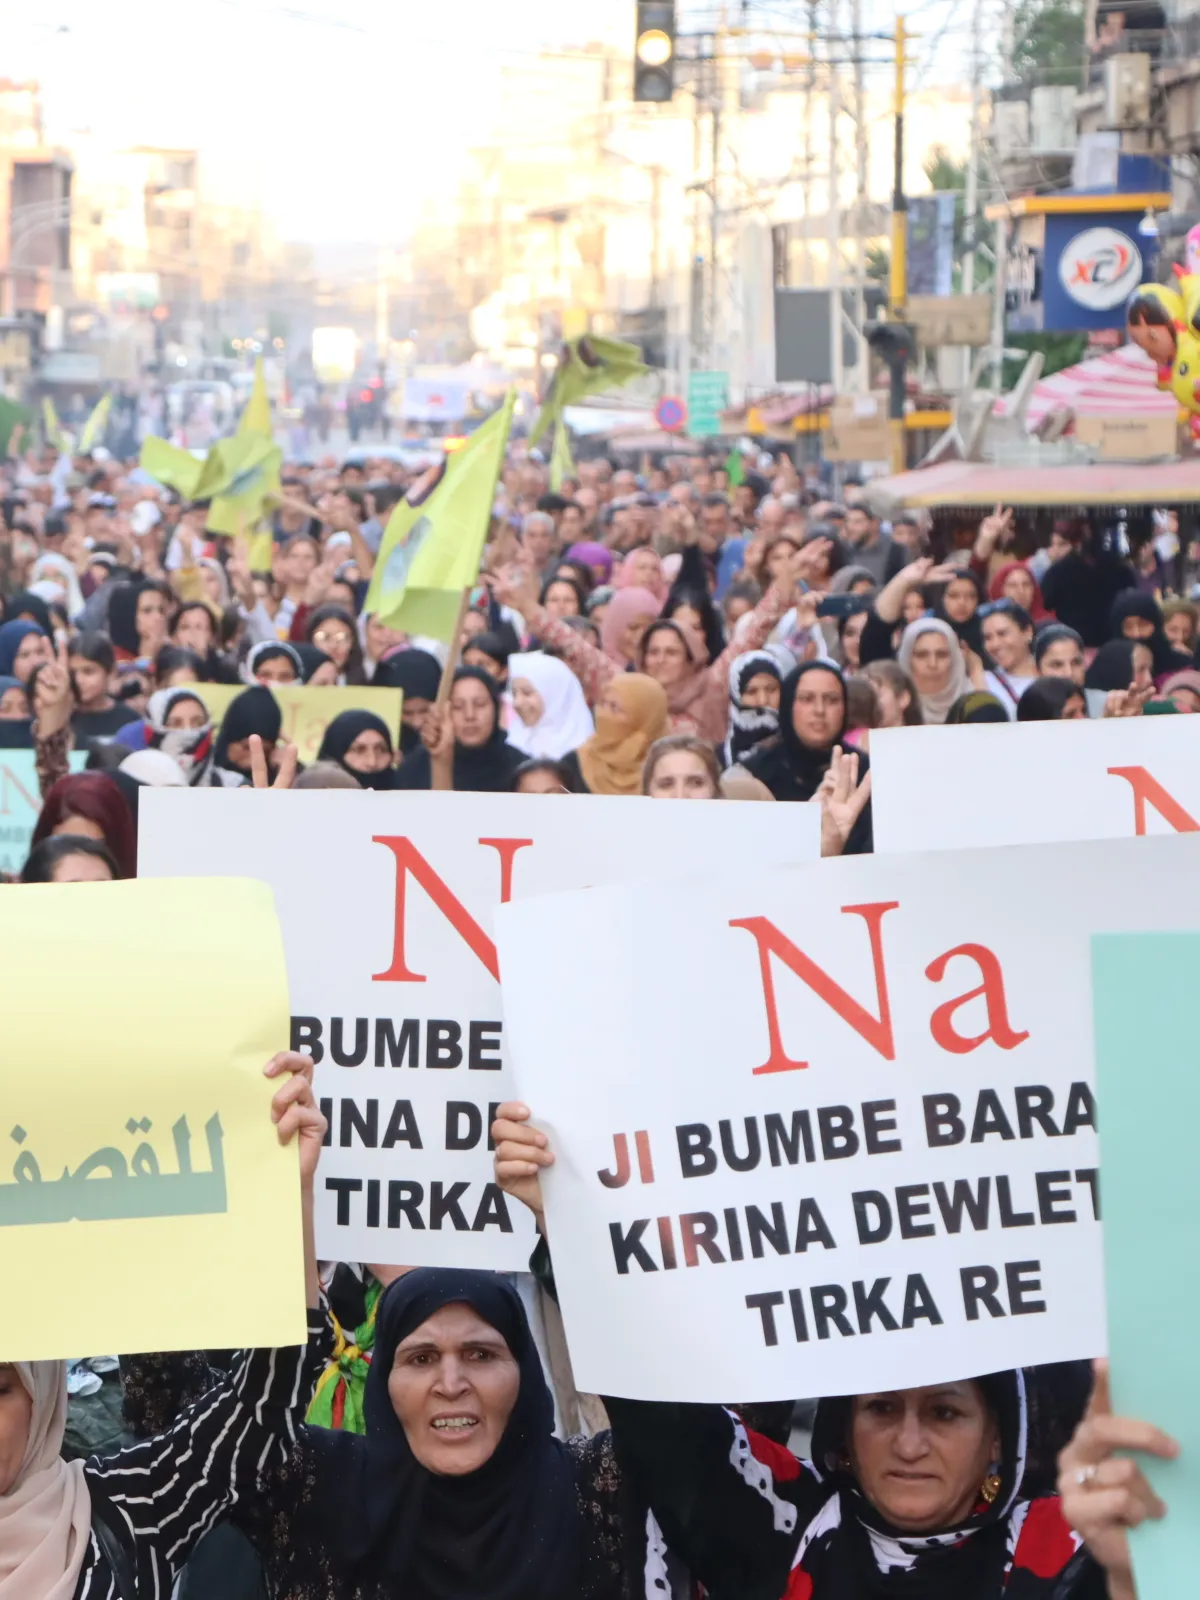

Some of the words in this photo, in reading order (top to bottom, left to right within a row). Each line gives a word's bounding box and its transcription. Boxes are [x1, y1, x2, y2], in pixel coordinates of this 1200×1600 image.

[728, 901, 1029, 1075] Na
[290, 1015, 503, 1071] BUMBE
[597, 1130, 654, 1188] JI
[675, 1099, 901, 1178] BUMBE
[922, 1081, 1098, 1147] BARA
[324, 1177, 514, 1233] TIRKA
[608, 1203, 836, 1275] KIRINA
[745, 1273, 942, 1346] TIRKA
[959, 1259, 1046, 1321] RE
